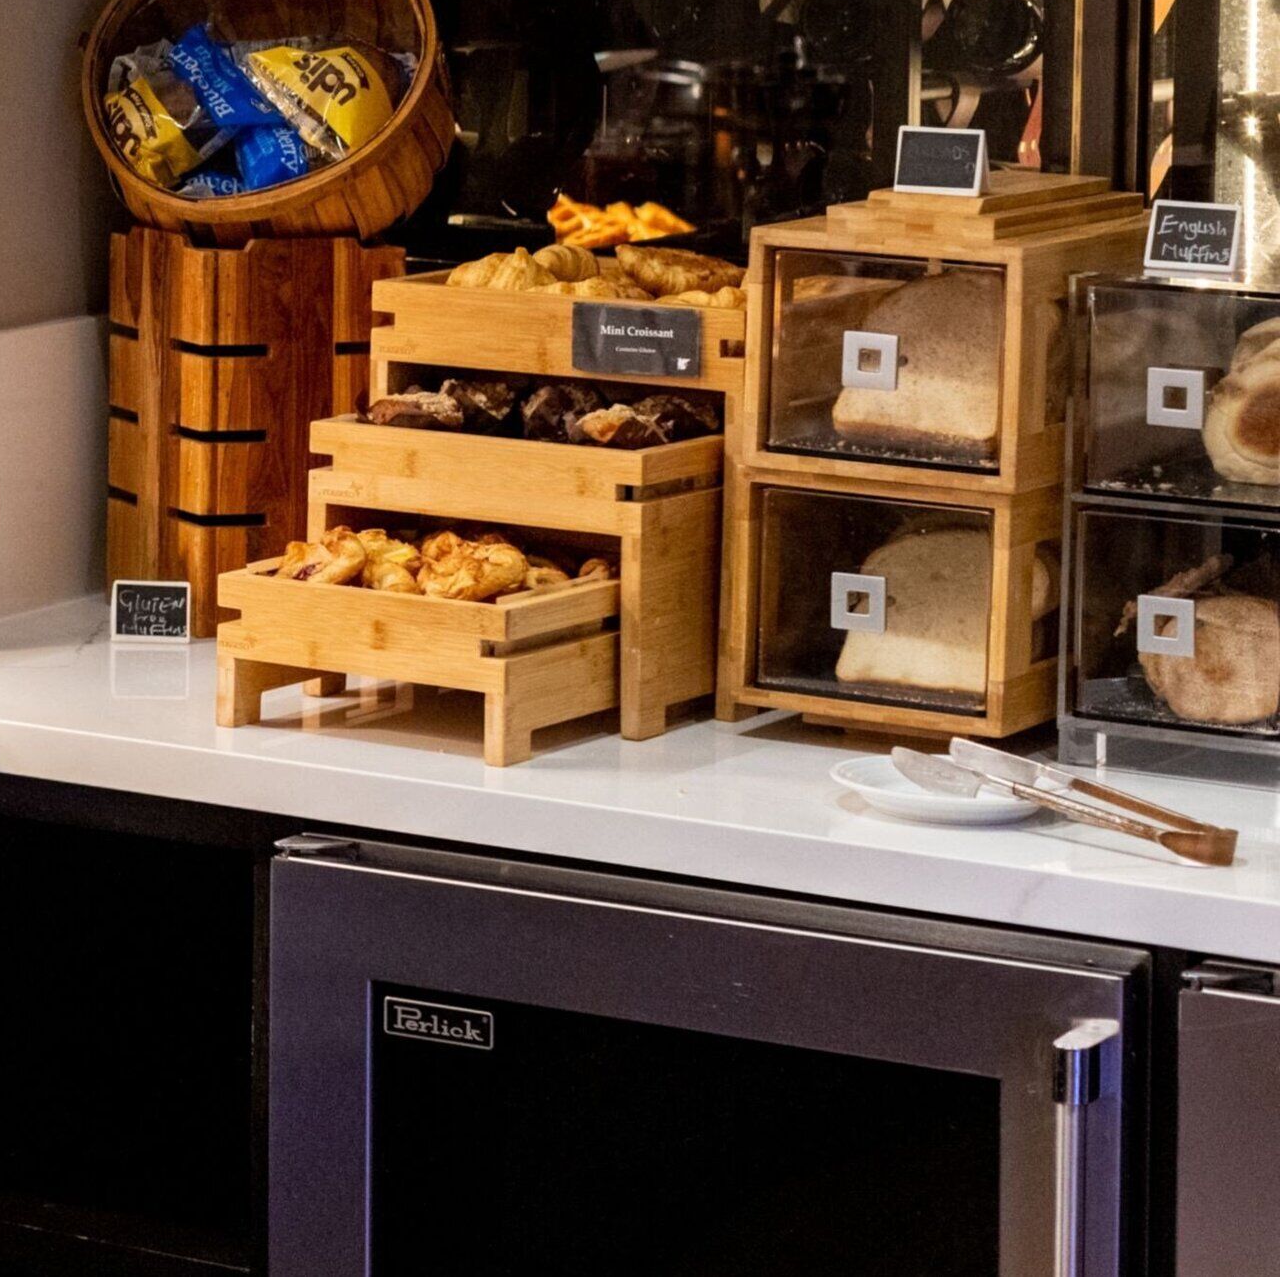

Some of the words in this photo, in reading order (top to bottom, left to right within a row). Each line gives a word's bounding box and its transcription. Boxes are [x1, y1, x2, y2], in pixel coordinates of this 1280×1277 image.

[1156, 213, 1228, 241] English
[1160, 242, 1231, 264] Muffins
[600, 325, 625, 336] Mini
[627, 326, 674, 339] Croissant
[393, 1005, 484, 1041] Perlick
